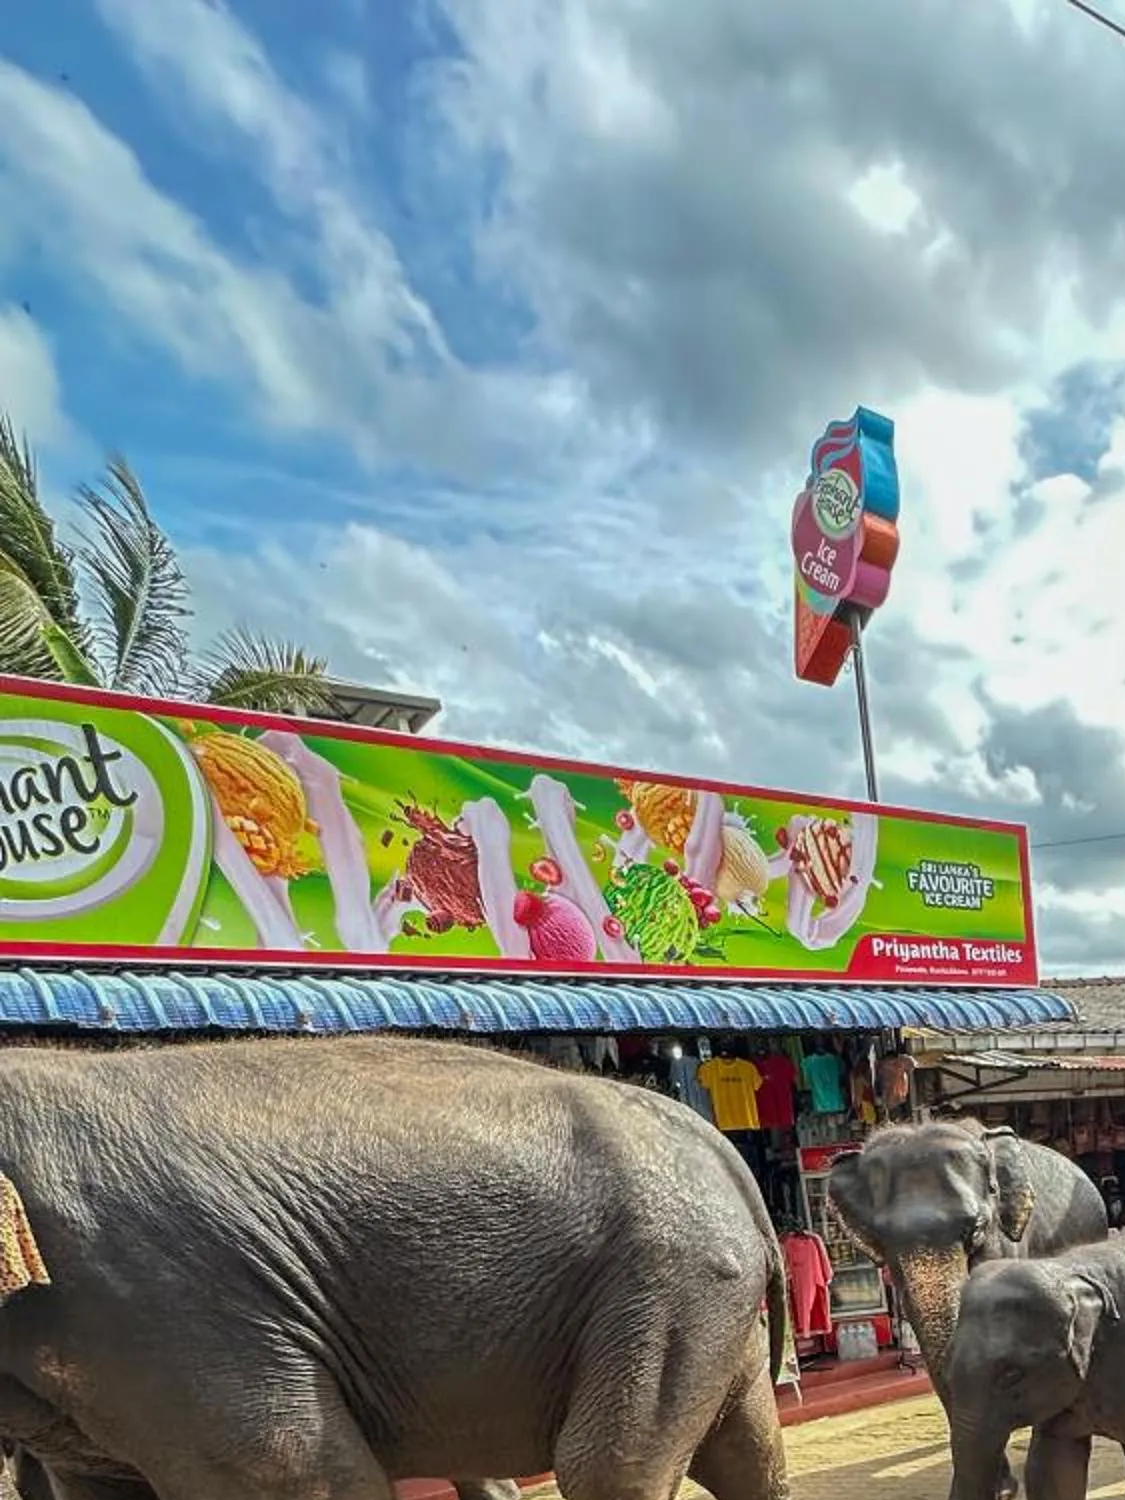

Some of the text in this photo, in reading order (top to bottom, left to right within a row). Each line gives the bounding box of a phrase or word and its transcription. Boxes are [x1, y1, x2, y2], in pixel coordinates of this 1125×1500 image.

[816, 536, 837, 566] Ice
[801, 551, 840, 591] Cream
[908, 872, 993, 897] FAVOURITE
[925, 892, 981, 909] ICE CREAM
[871, 937, 1023, 963] Priyantha Textiles
